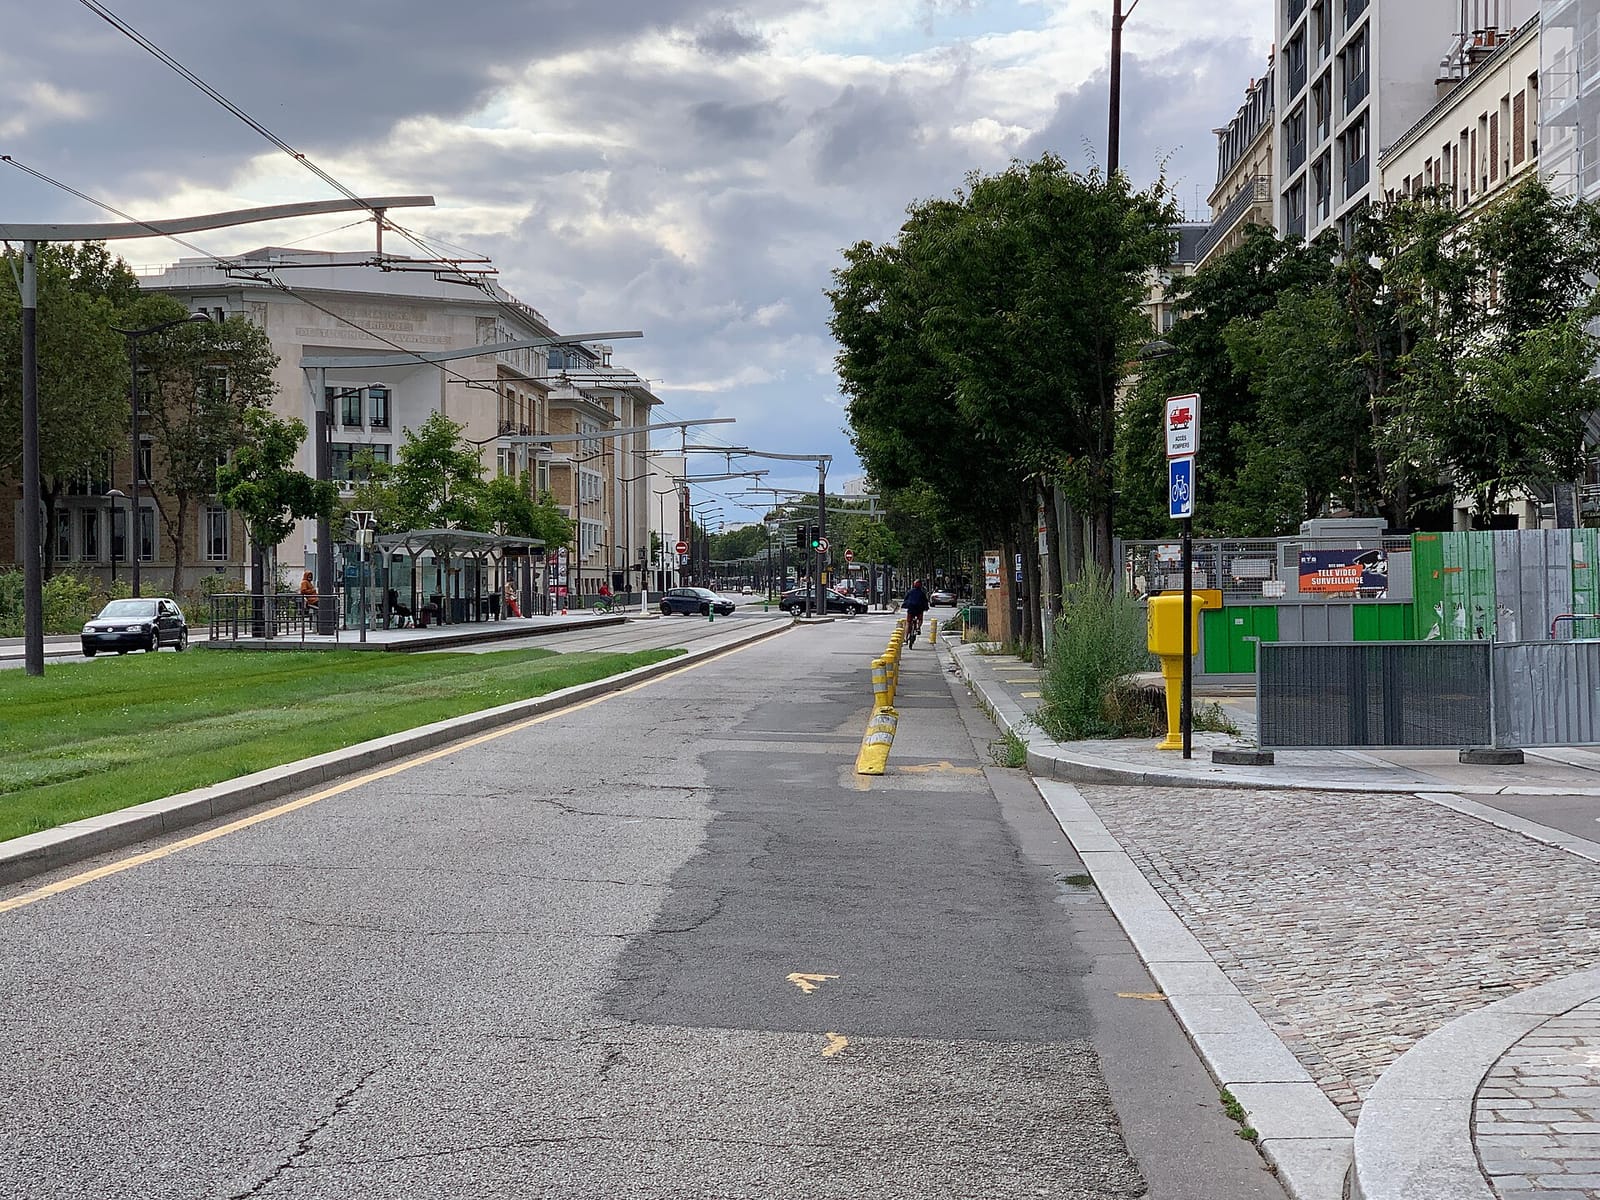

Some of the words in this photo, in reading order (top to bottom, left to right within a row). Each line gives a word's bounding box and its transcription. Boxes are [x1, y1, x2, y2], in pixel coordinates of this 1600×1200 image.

[1318, 569, 1335, 577] TELE
[1335, 568, 1357, 577] VIDEO
[1311, 576, 1364, 585] SURVEILLANCE
